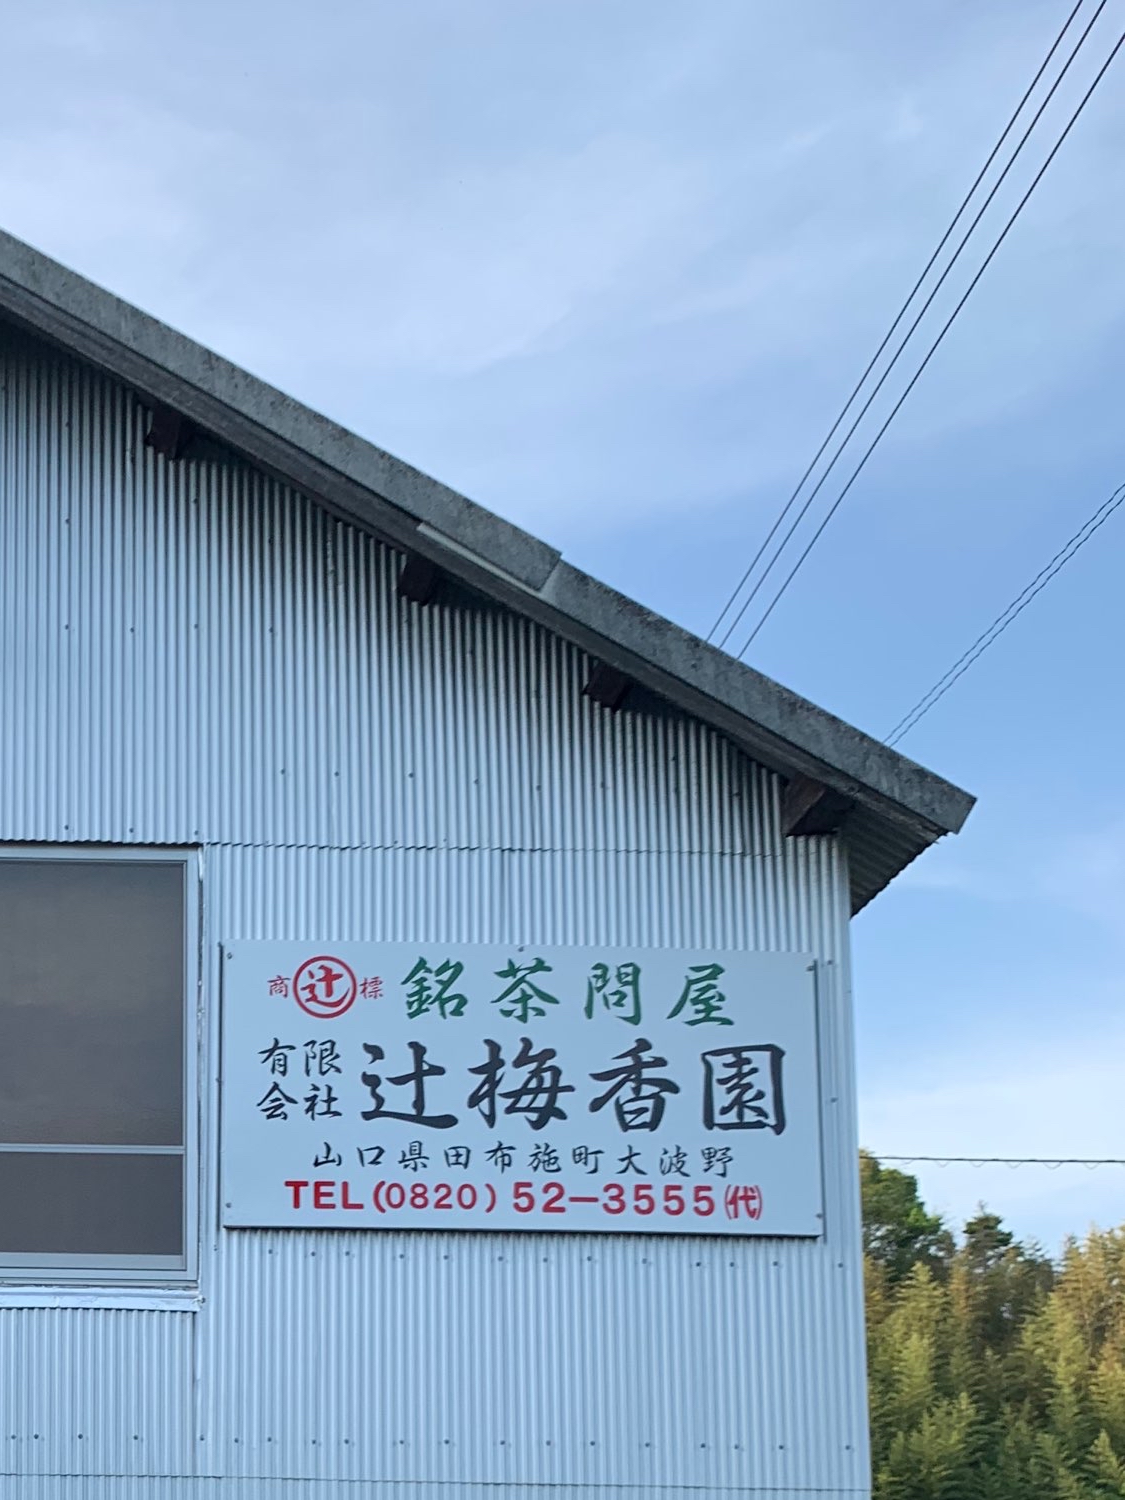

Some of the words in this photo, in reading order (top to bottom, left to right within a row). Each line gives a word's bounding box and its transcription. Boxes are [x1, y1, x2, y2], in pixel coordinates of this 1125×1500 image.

[400, 956, 735, 1026] 銘茶問屋
[258, 1037, 342, 1077] 有限
[256, 1081, 342, 1121] 会社
[360, 1037, 786, 1136] 辻梅香園
[313, 1140, 734, 1178] 山口県田布施町大波野
